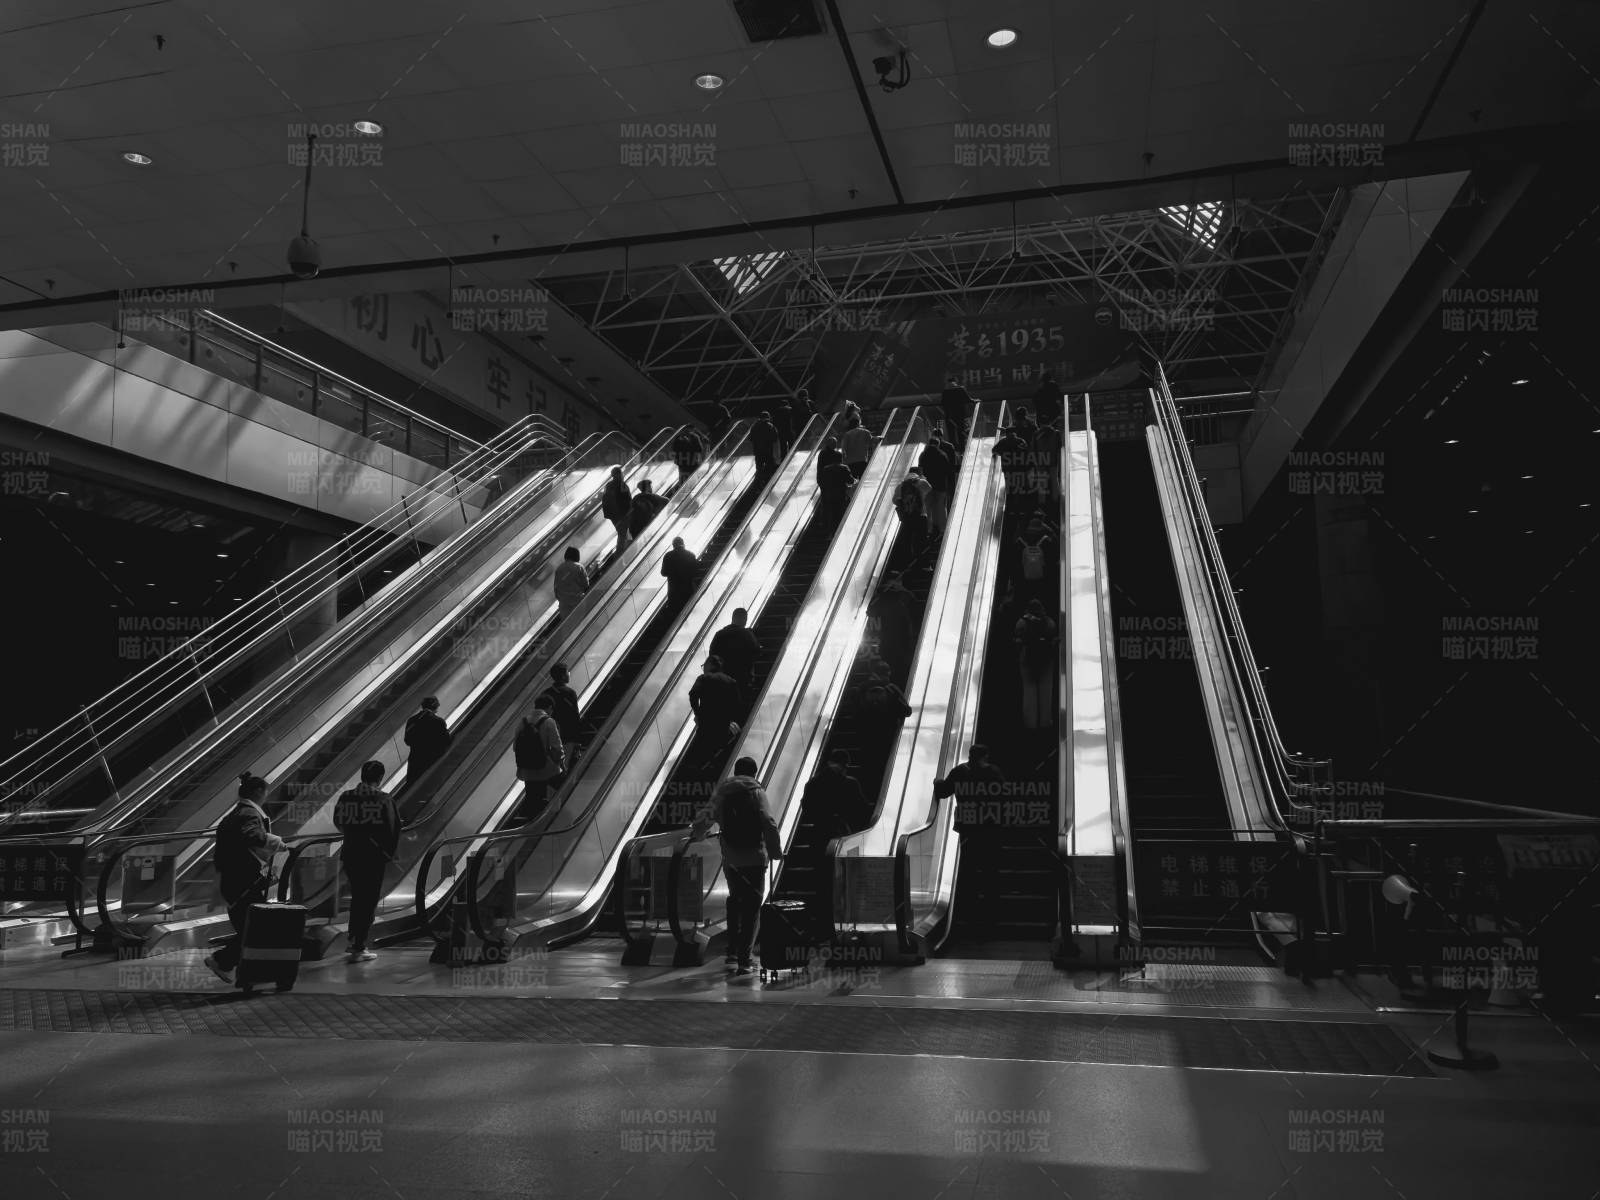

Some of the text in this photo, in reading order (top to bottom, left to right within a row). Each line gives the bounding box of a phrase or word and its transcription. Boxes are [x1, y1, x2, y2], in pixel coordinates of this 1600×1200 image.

[1160, 854, 1270, 874] 电梯维保
[1160, 878, 1269, 898] 禁止通行
